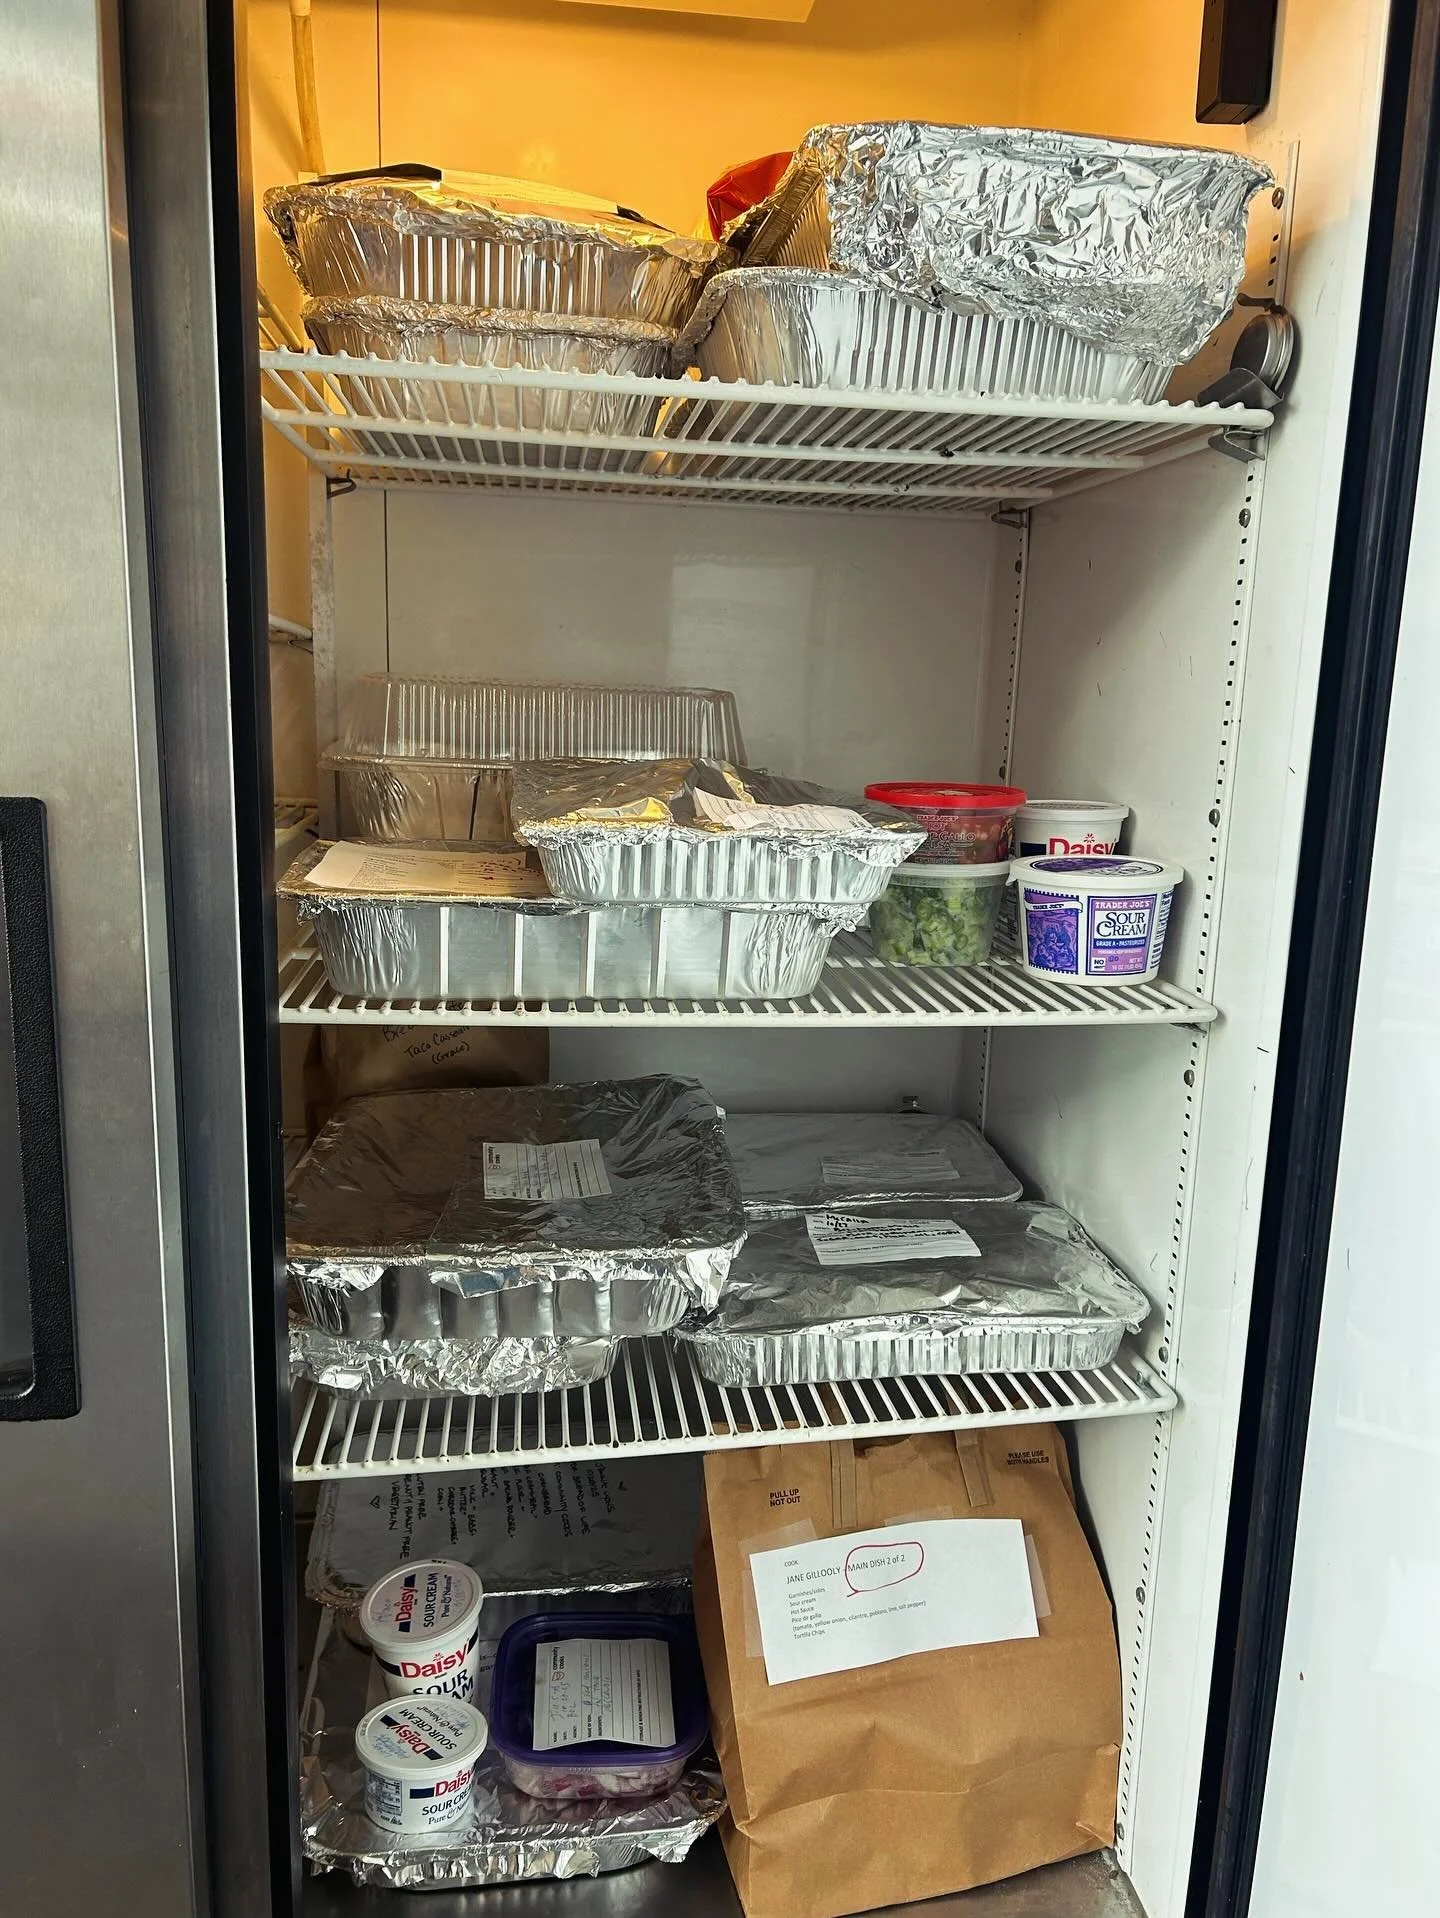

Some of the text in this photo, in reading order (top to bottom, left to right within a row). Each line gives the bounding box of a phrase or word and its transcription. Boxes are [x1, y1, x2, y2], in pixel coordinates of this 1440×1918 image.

[939, 831, 976, 843] GALLO
[1105, 912, 1145, 926] SOUR
[1096, 921, 1146, 937] CREAM
[405, 1043, 431, 1059] Taco
[770, 1488, 799, 1499] PULL UP
[770, 1496, 801, 1507] NOT OUT
[786, 1572, 804, 1584] JANE
[806, 1567, 841, 1581] GILLOOLY
[848, 1561, 869, 1572] MAIN
[870, 1558, 886, 1568] DISH
[887, 1557, 892, 1565] 2
[892, 1556, 899, 1564] of
[900, 1554, 906, 1562] 2
[395, 1587, 418, 1622] Daisy
[424, 1573, 438, 1628] SOUR CREAM
[801, 1597, 816, 1605] cream
[441, 1604, 450, 1617] Pure
[791, 1615, 802, 1623] Pico
[809, 1612, 822, 1622] gallo
[792, 1622, 814, 1632] (tomato,
[814, 1619, 831, 1629] yellow
[831, 1616, 848, 1625] onion,
[794, 1629, 826, 1640] Tortilla Chips
[401, 1644, 469, 1679] Daisy
[552, 1646, 560, 1671] community
[399, 1709, 432, 1732] CREAM
[440, 1720, 450, 1728] &
[448, 1725, 463, 1737] Pure
[391, 1724, 431, 1755] Daisy
[428, 1729, 457, 1750] SOUR
[435, 1770, 474, 1797] Daisy
[422, 1799, 452, 1816] SOUR
[428, 1814, 446, 1825] Pure
